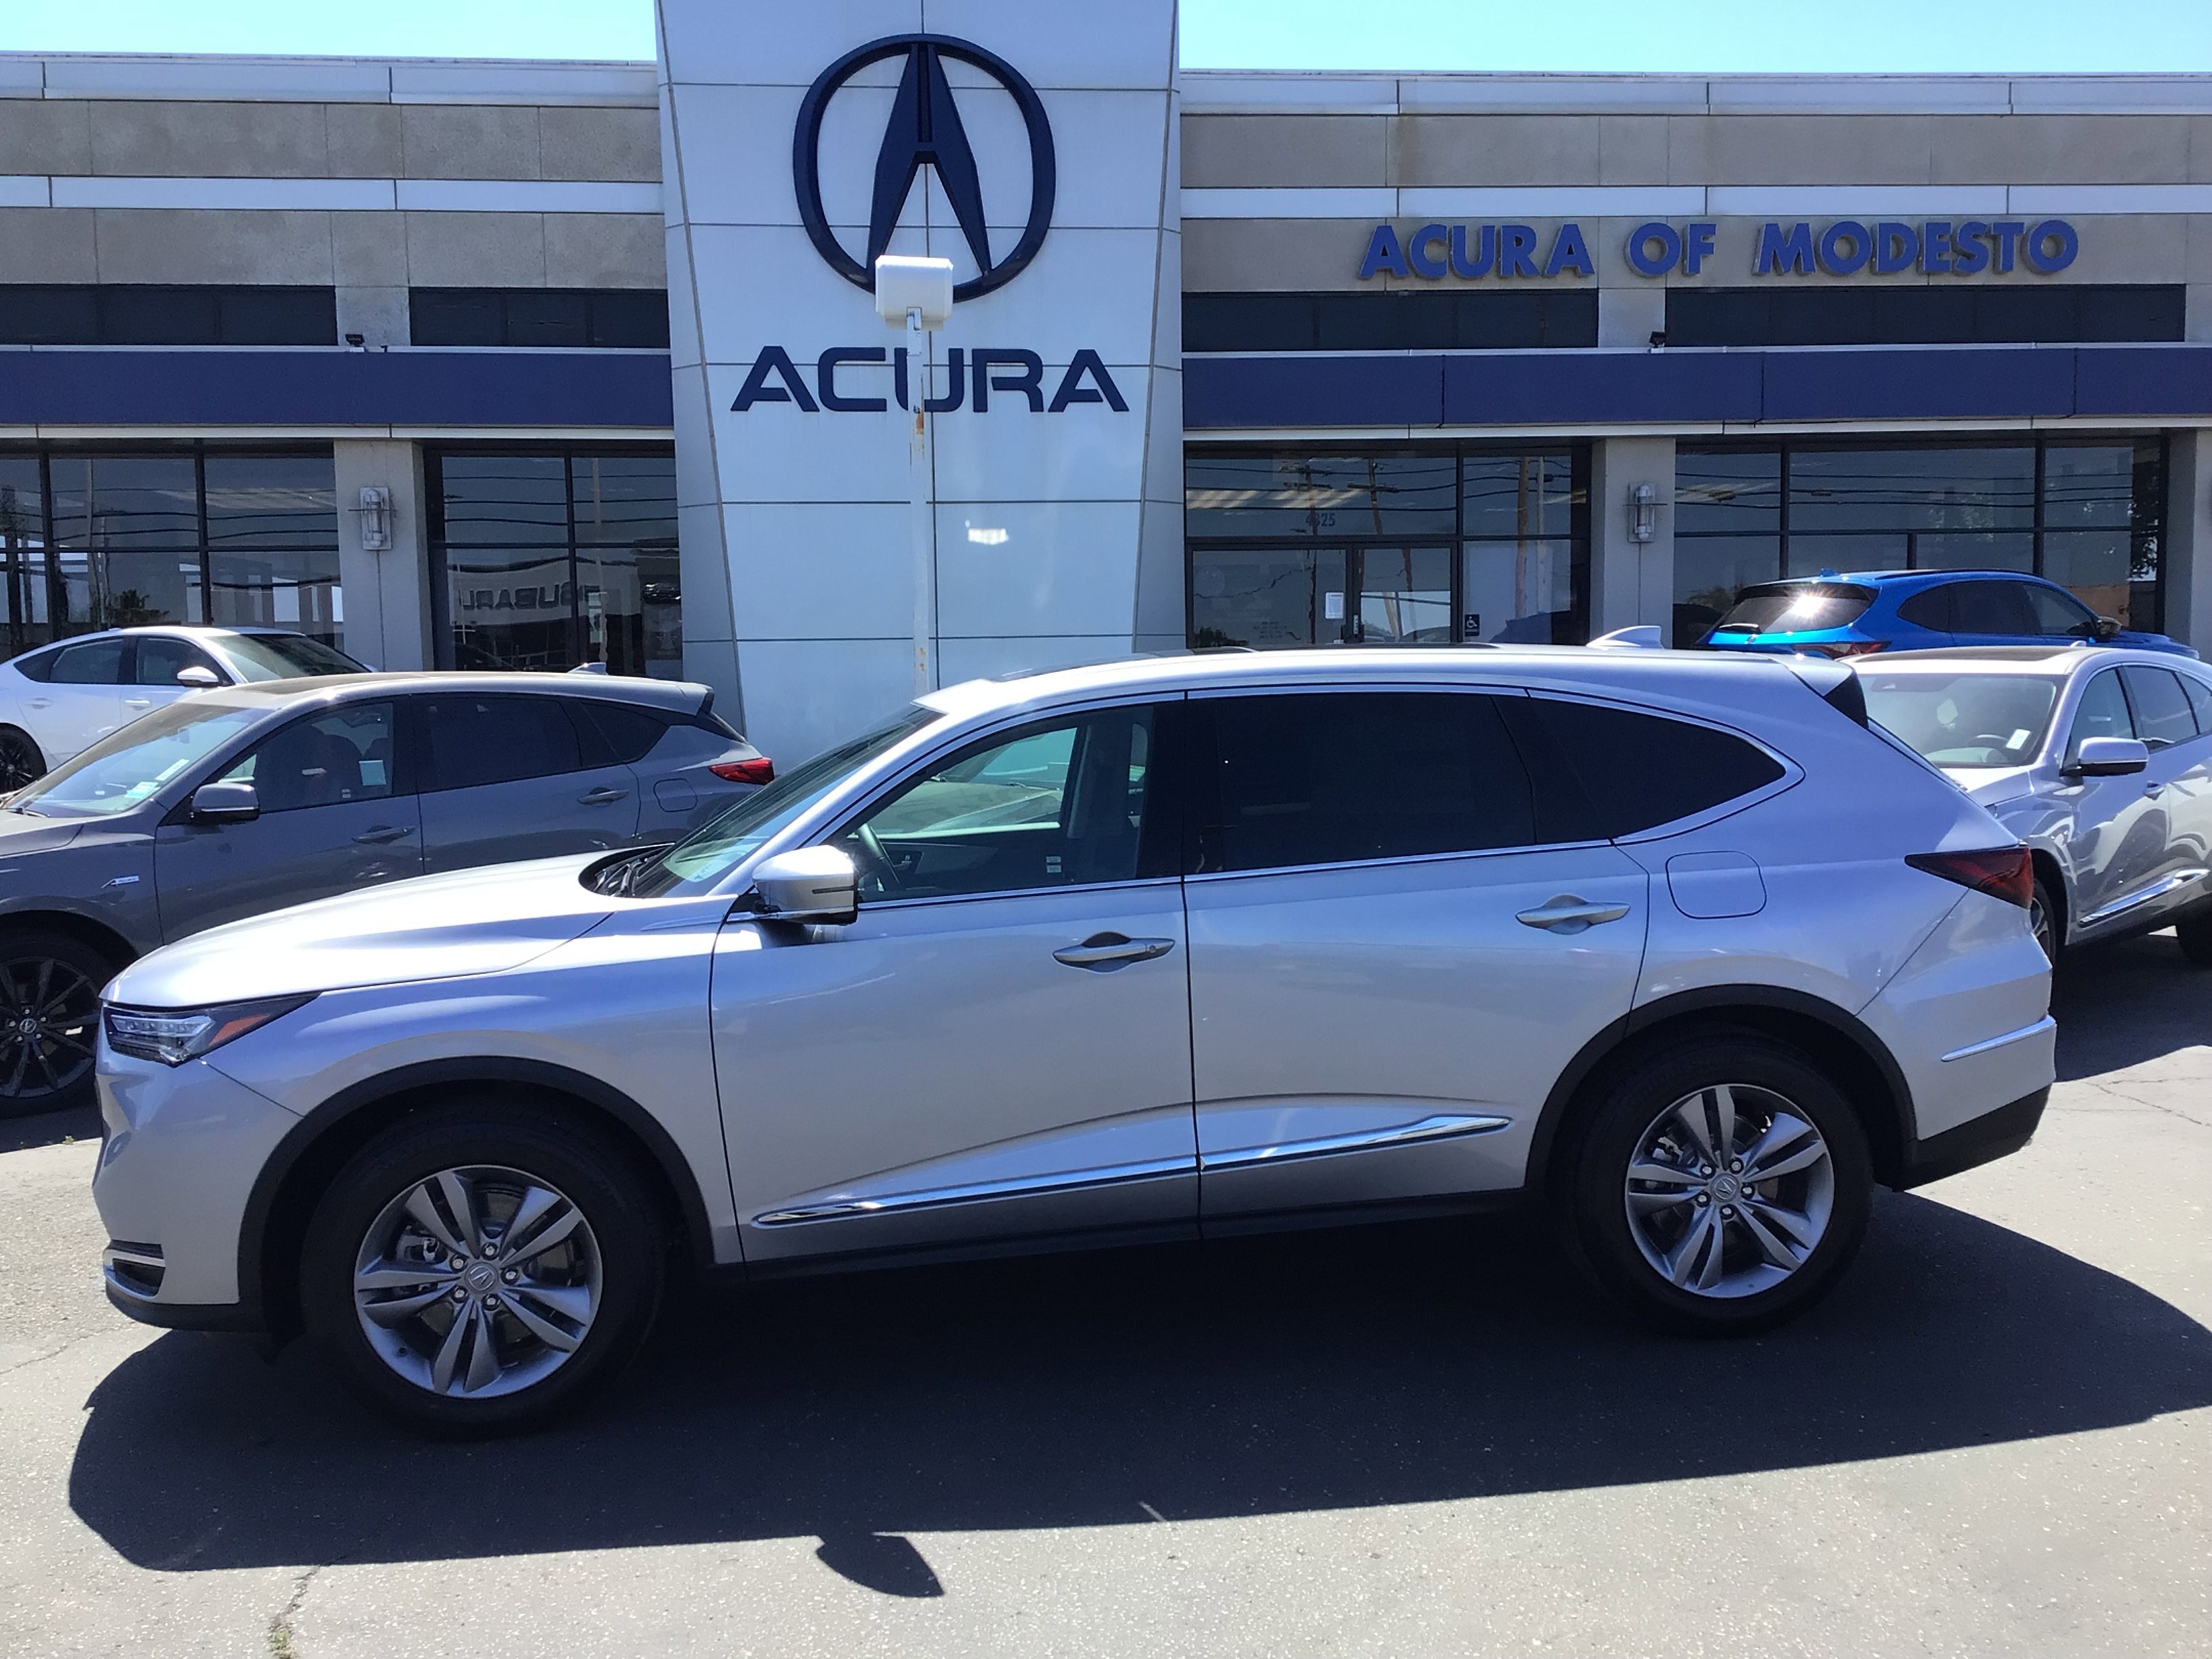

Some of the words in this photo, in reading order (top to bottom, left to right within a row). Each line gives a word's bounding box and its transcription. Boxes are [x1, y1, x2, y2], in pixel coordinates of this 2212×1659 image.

[1359, 224, 1595, 279] ACURA
[1629, 222, 1717, 276] OF
[1757, 220, 2078, 276] MODESTO
[730, 345, 1130, 413] ACURA
